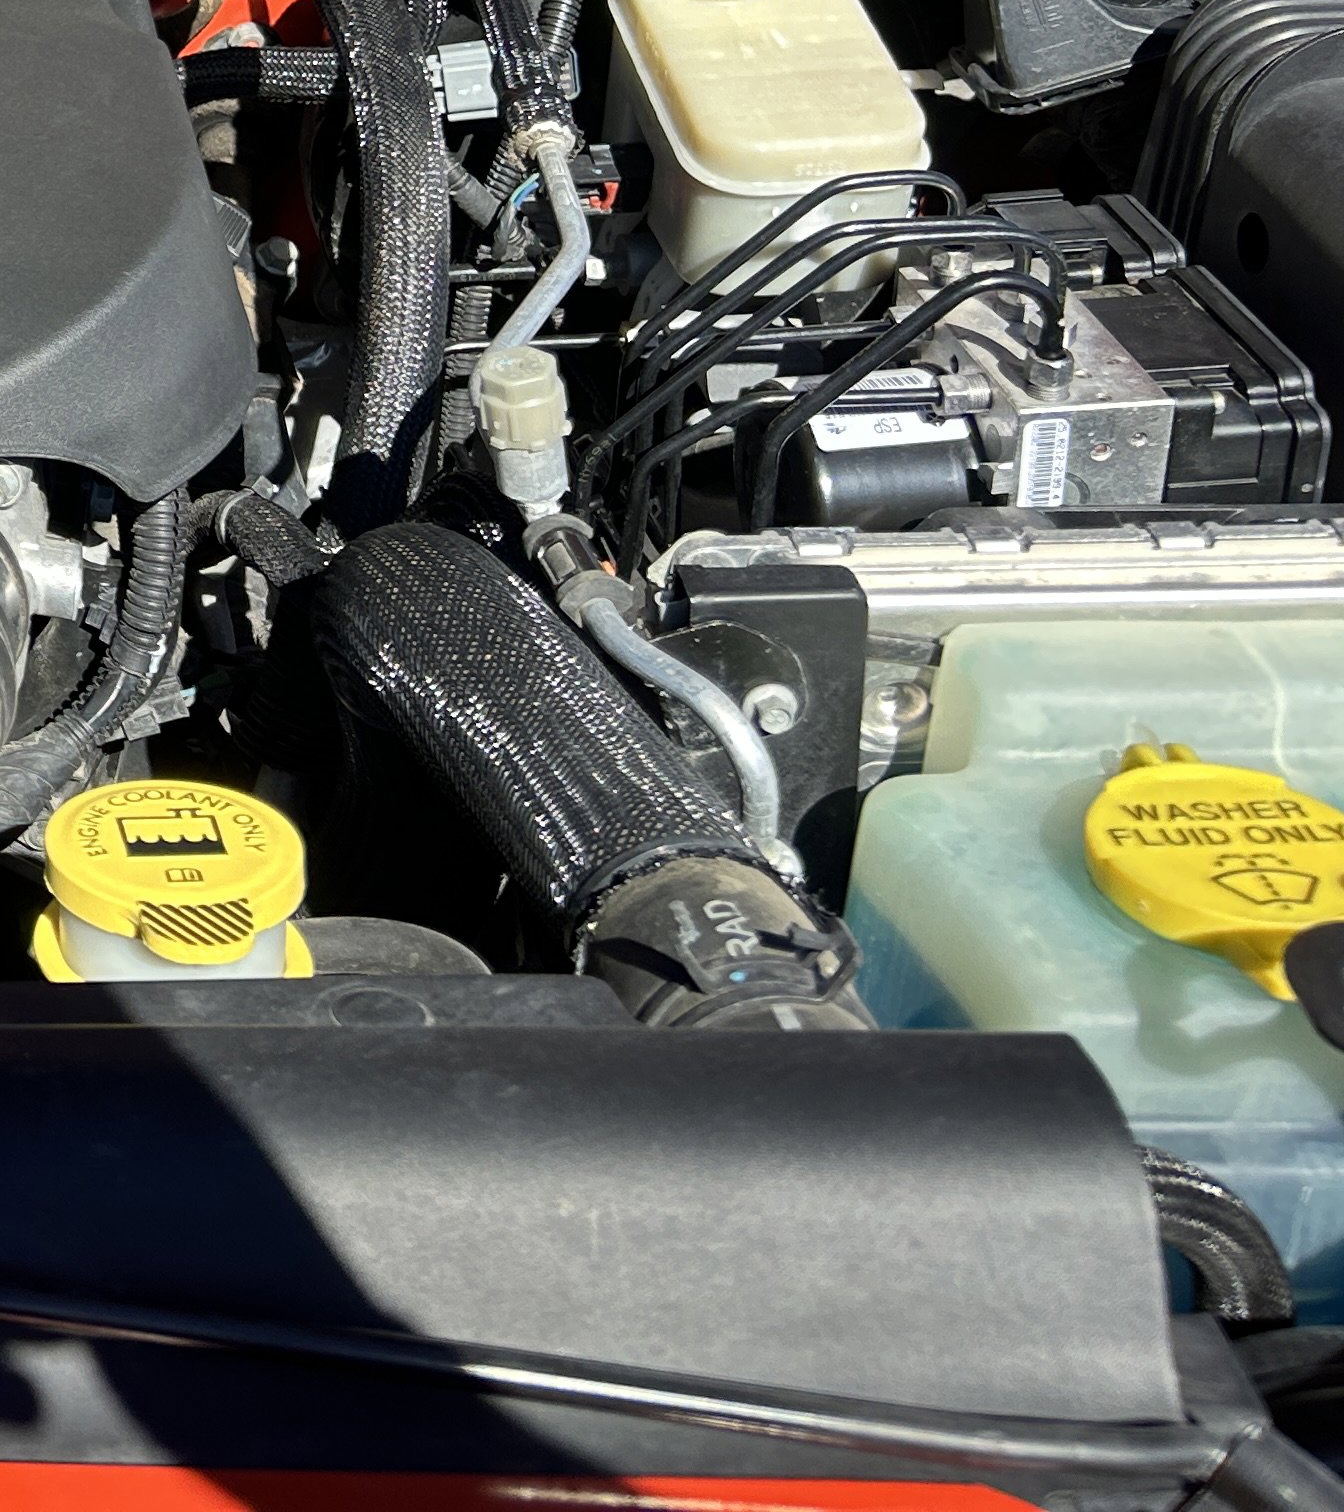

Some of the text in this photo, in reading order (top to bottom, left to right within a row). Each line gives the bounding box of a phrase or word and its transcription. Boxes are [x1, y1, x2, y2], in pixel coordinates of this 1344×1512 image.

[873, 417, 902, 434] ESP
[76, 789, 268, 858] ENGINE COOLANT ONLY
[1118, 799, 1309, 823] WASHER
[1106, 822, 1344, 847] FLUID ONLY
[702, 899, 759, 958] RAD
